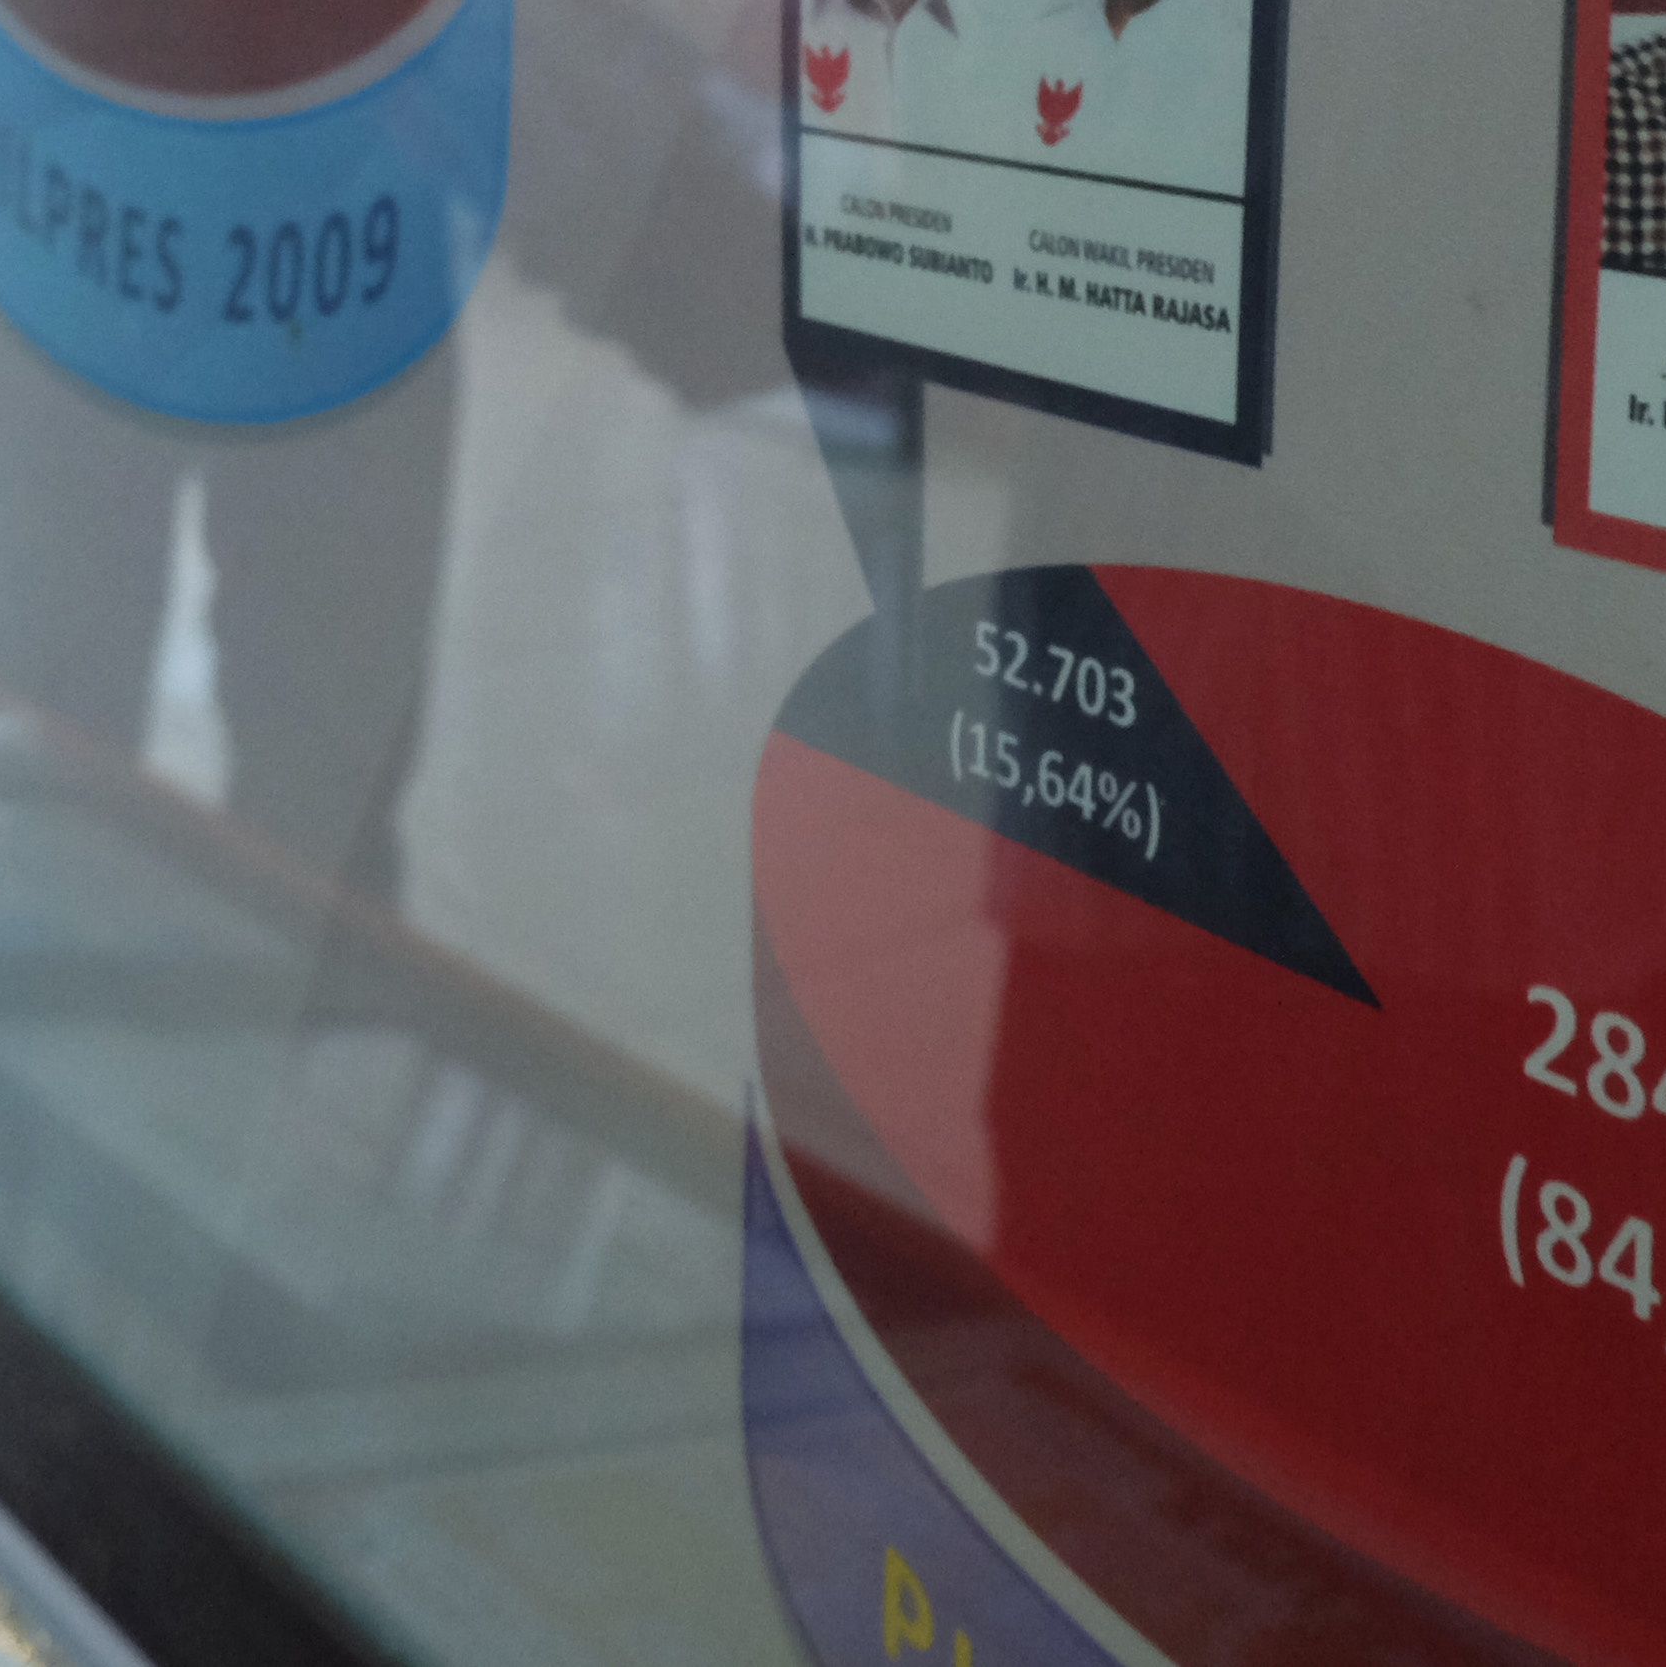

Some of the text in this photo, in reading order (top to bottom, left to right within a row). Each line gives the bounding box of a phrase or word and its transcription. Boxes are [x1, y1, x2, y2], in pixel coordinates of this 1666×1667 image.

[890, 201, 953, 233] PRESIDEN
[223, 195, 399, 324] 2009
[1029, 229, 1216, 285] CALON WAKIL PRESIDEN
[1036, 272, 1055, 297] H.
[1058, 277, 1081, 302] M.
[1086, 281, 1147, 318] HATTA
[1152, 293, 1231, 333] RAJASA
[1628, 393, 1654, 426] Ir.
[974, 620, 1137, 729] 52.703
[950, 709, 1161, 860] (15,64%)
